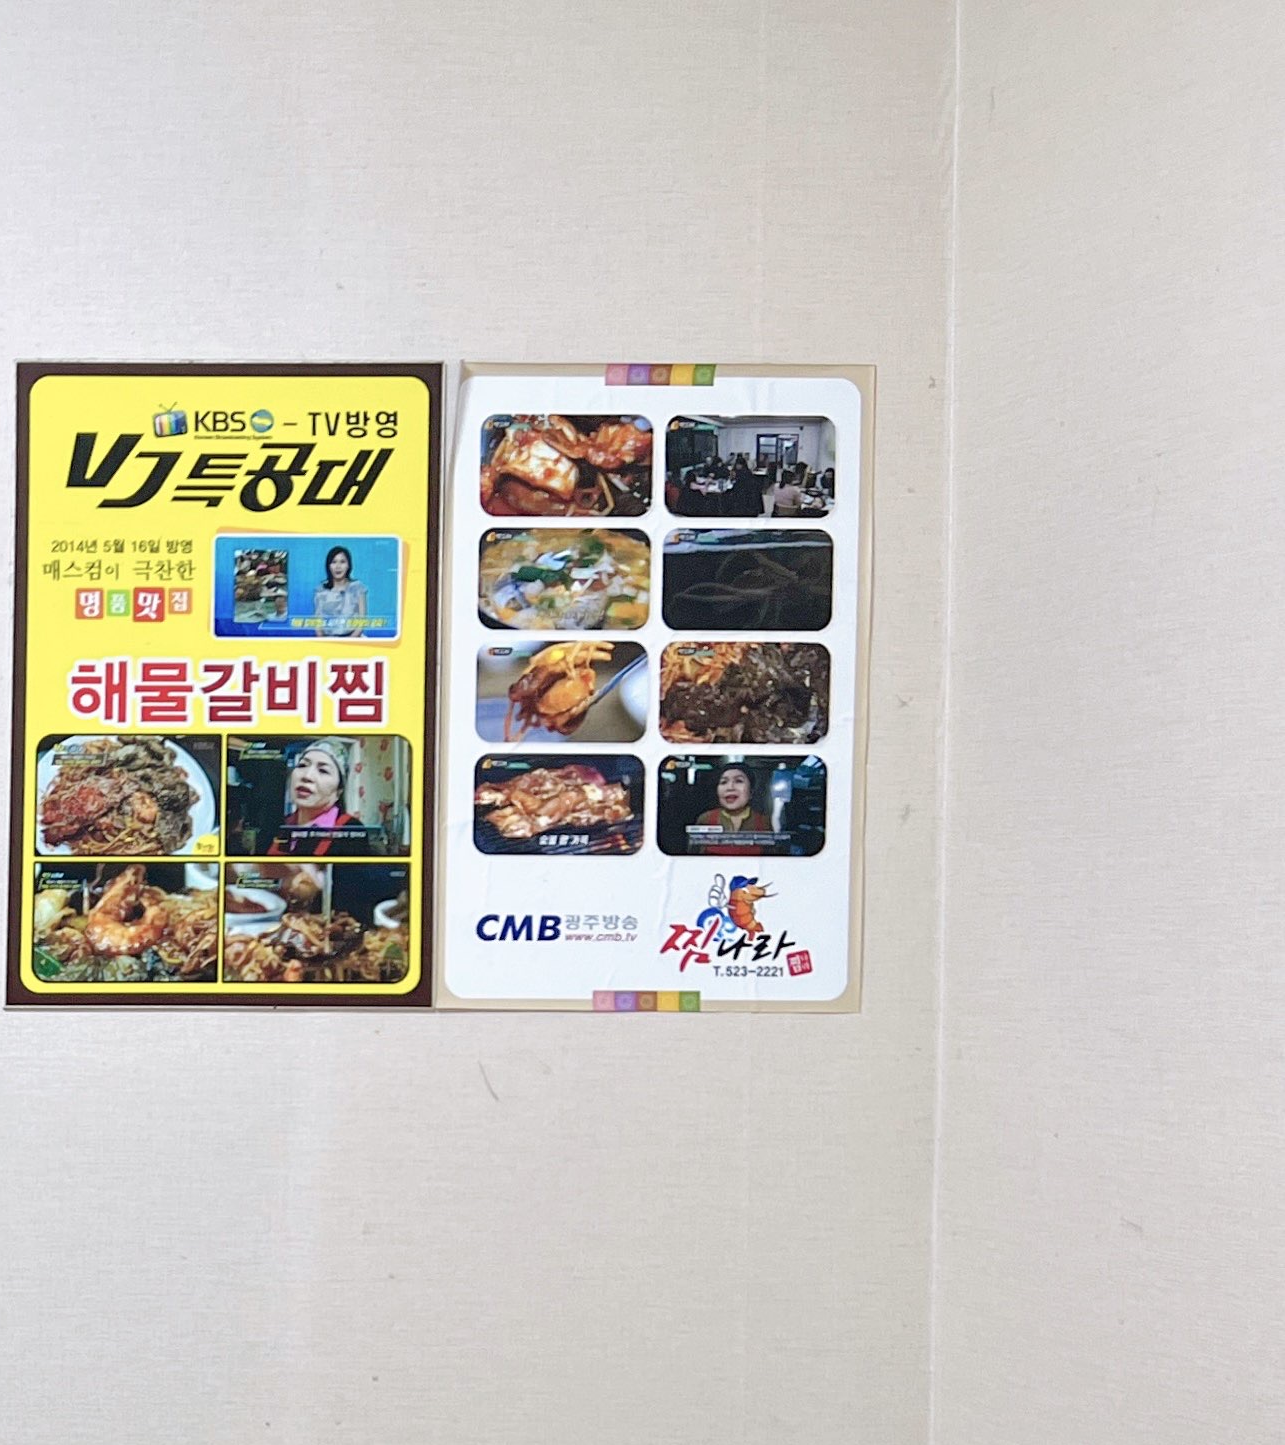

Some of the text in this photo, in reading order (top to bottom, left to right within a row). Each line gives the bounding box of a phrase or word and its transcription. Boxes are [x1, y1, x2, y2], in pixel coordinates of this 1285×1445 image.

[194, 411, 398, 438] KBS TV방영
[65, 431, 395, 512] VJ특공대
[51, 538, 193, 554] 2014년 5월 16일 방영
[42, 559, 196, 581] 매스컴이 극찬한
[69, 660, 385, 724] 해물갈비찜
[476, 914, 561, 941] CMB
[565, 914, 639, 930] 광주방송
[565, 931, 639, 943] www.cmb.tv
[660, 918, 796, 972] 찜나라
[713, 966, 784, 978] T.523-2221
